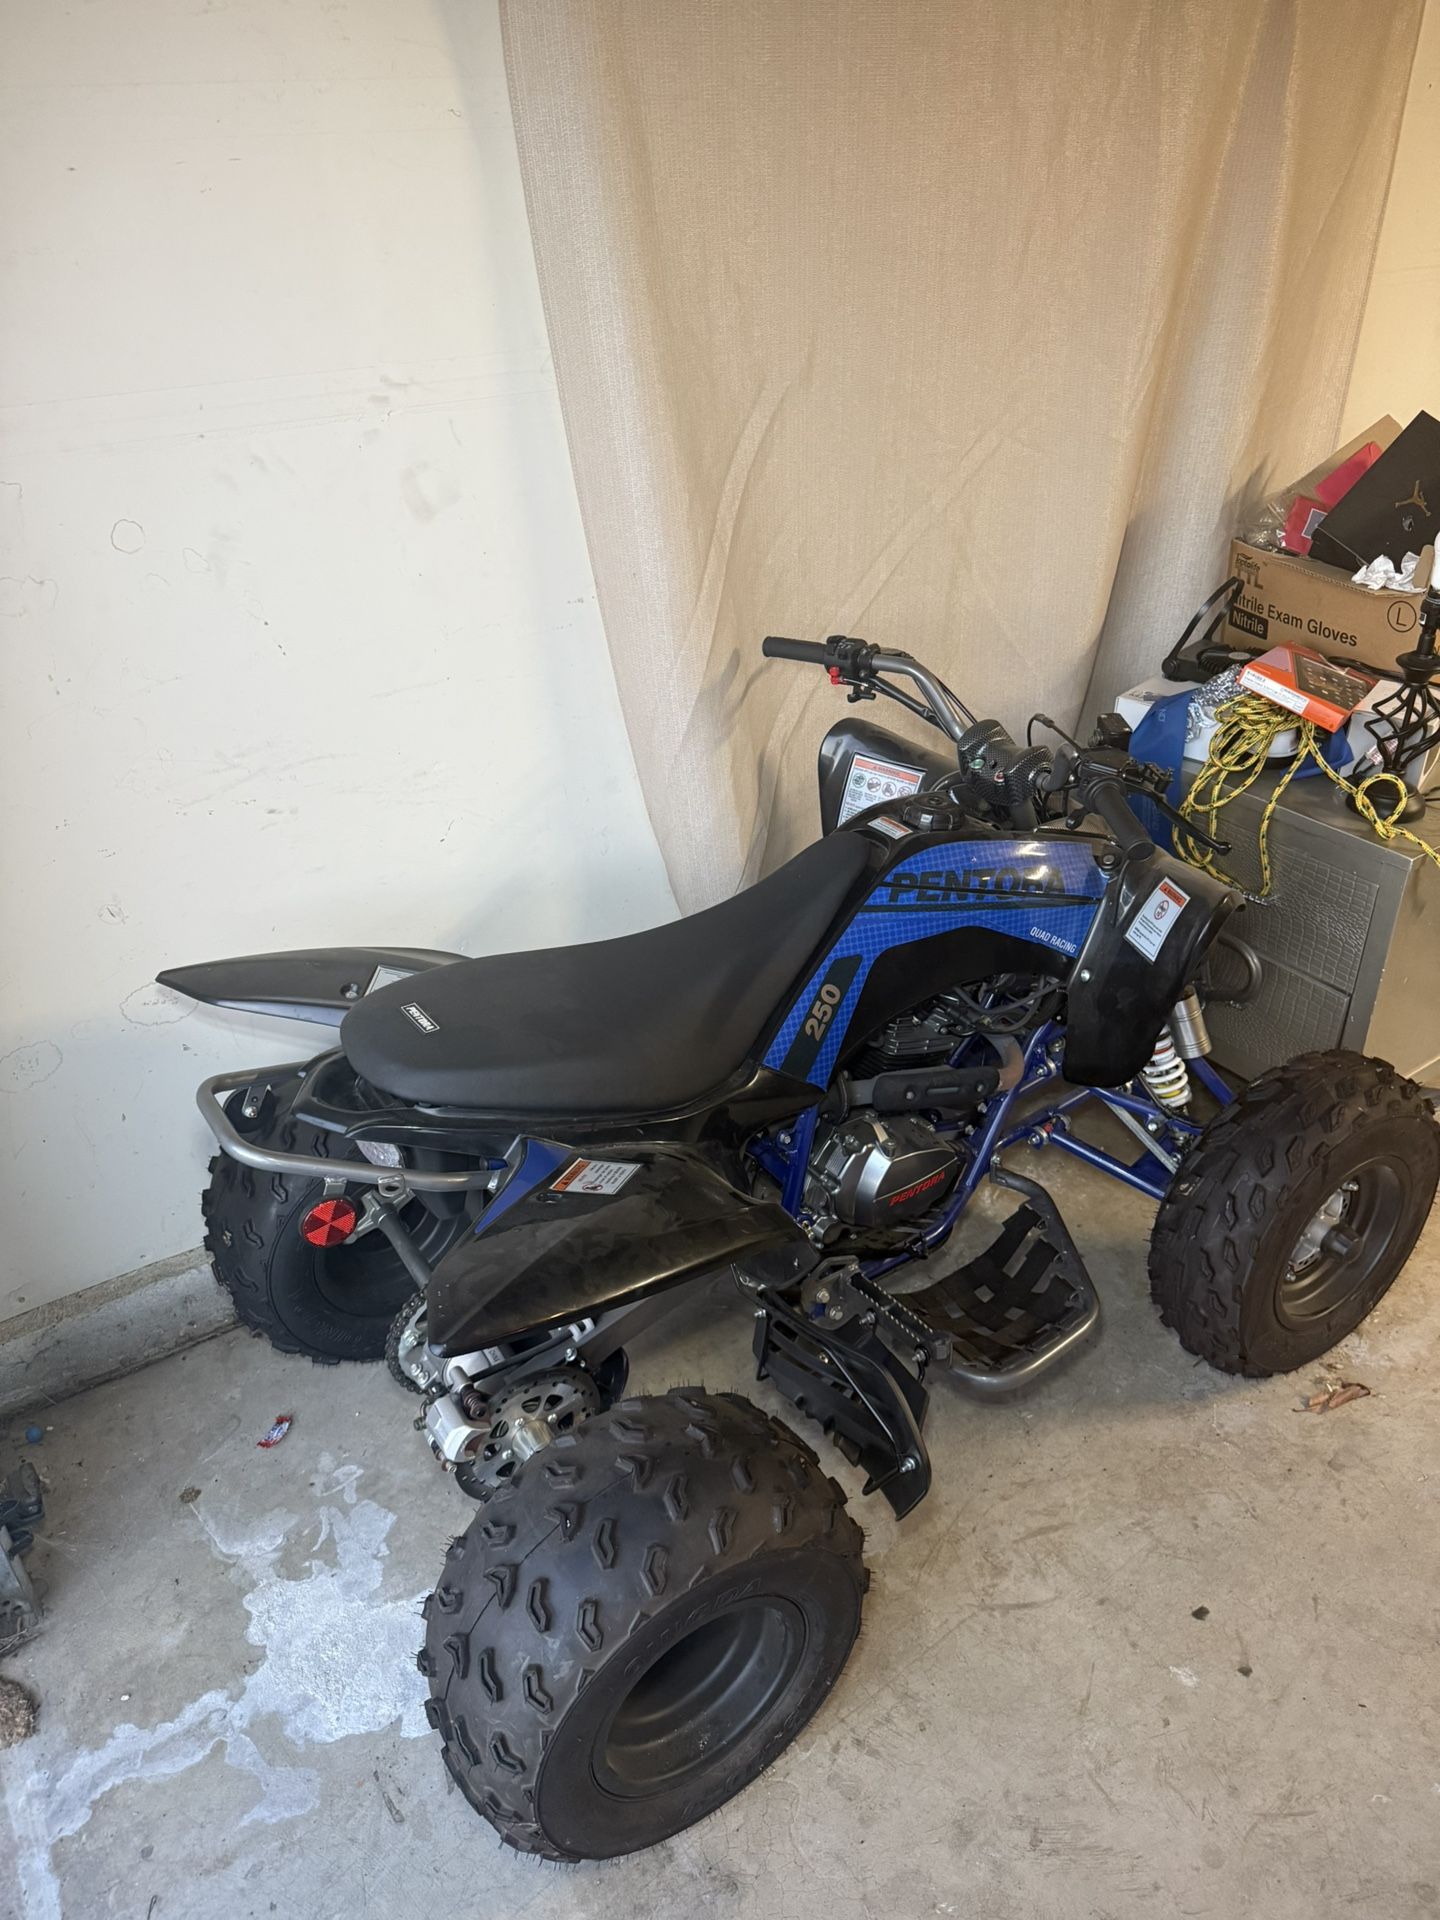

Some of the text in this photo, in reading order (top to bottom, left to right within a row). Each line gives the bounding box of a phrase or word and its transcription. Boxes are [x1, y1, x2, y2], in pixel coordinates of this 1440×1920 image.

[1232, 610, 1265, 635] Nitrile
[1234, 593, 1359, 647] itrile Exam Gloves
[1395, 607, 1408, 627] L
[888, 865, 1067, 904] PENTORA
[1029, 926, 1077, 954] QUAD RACING
[804, 983, 841, 1042] 250
[888, 1170, 945, 1206] PENTORA
